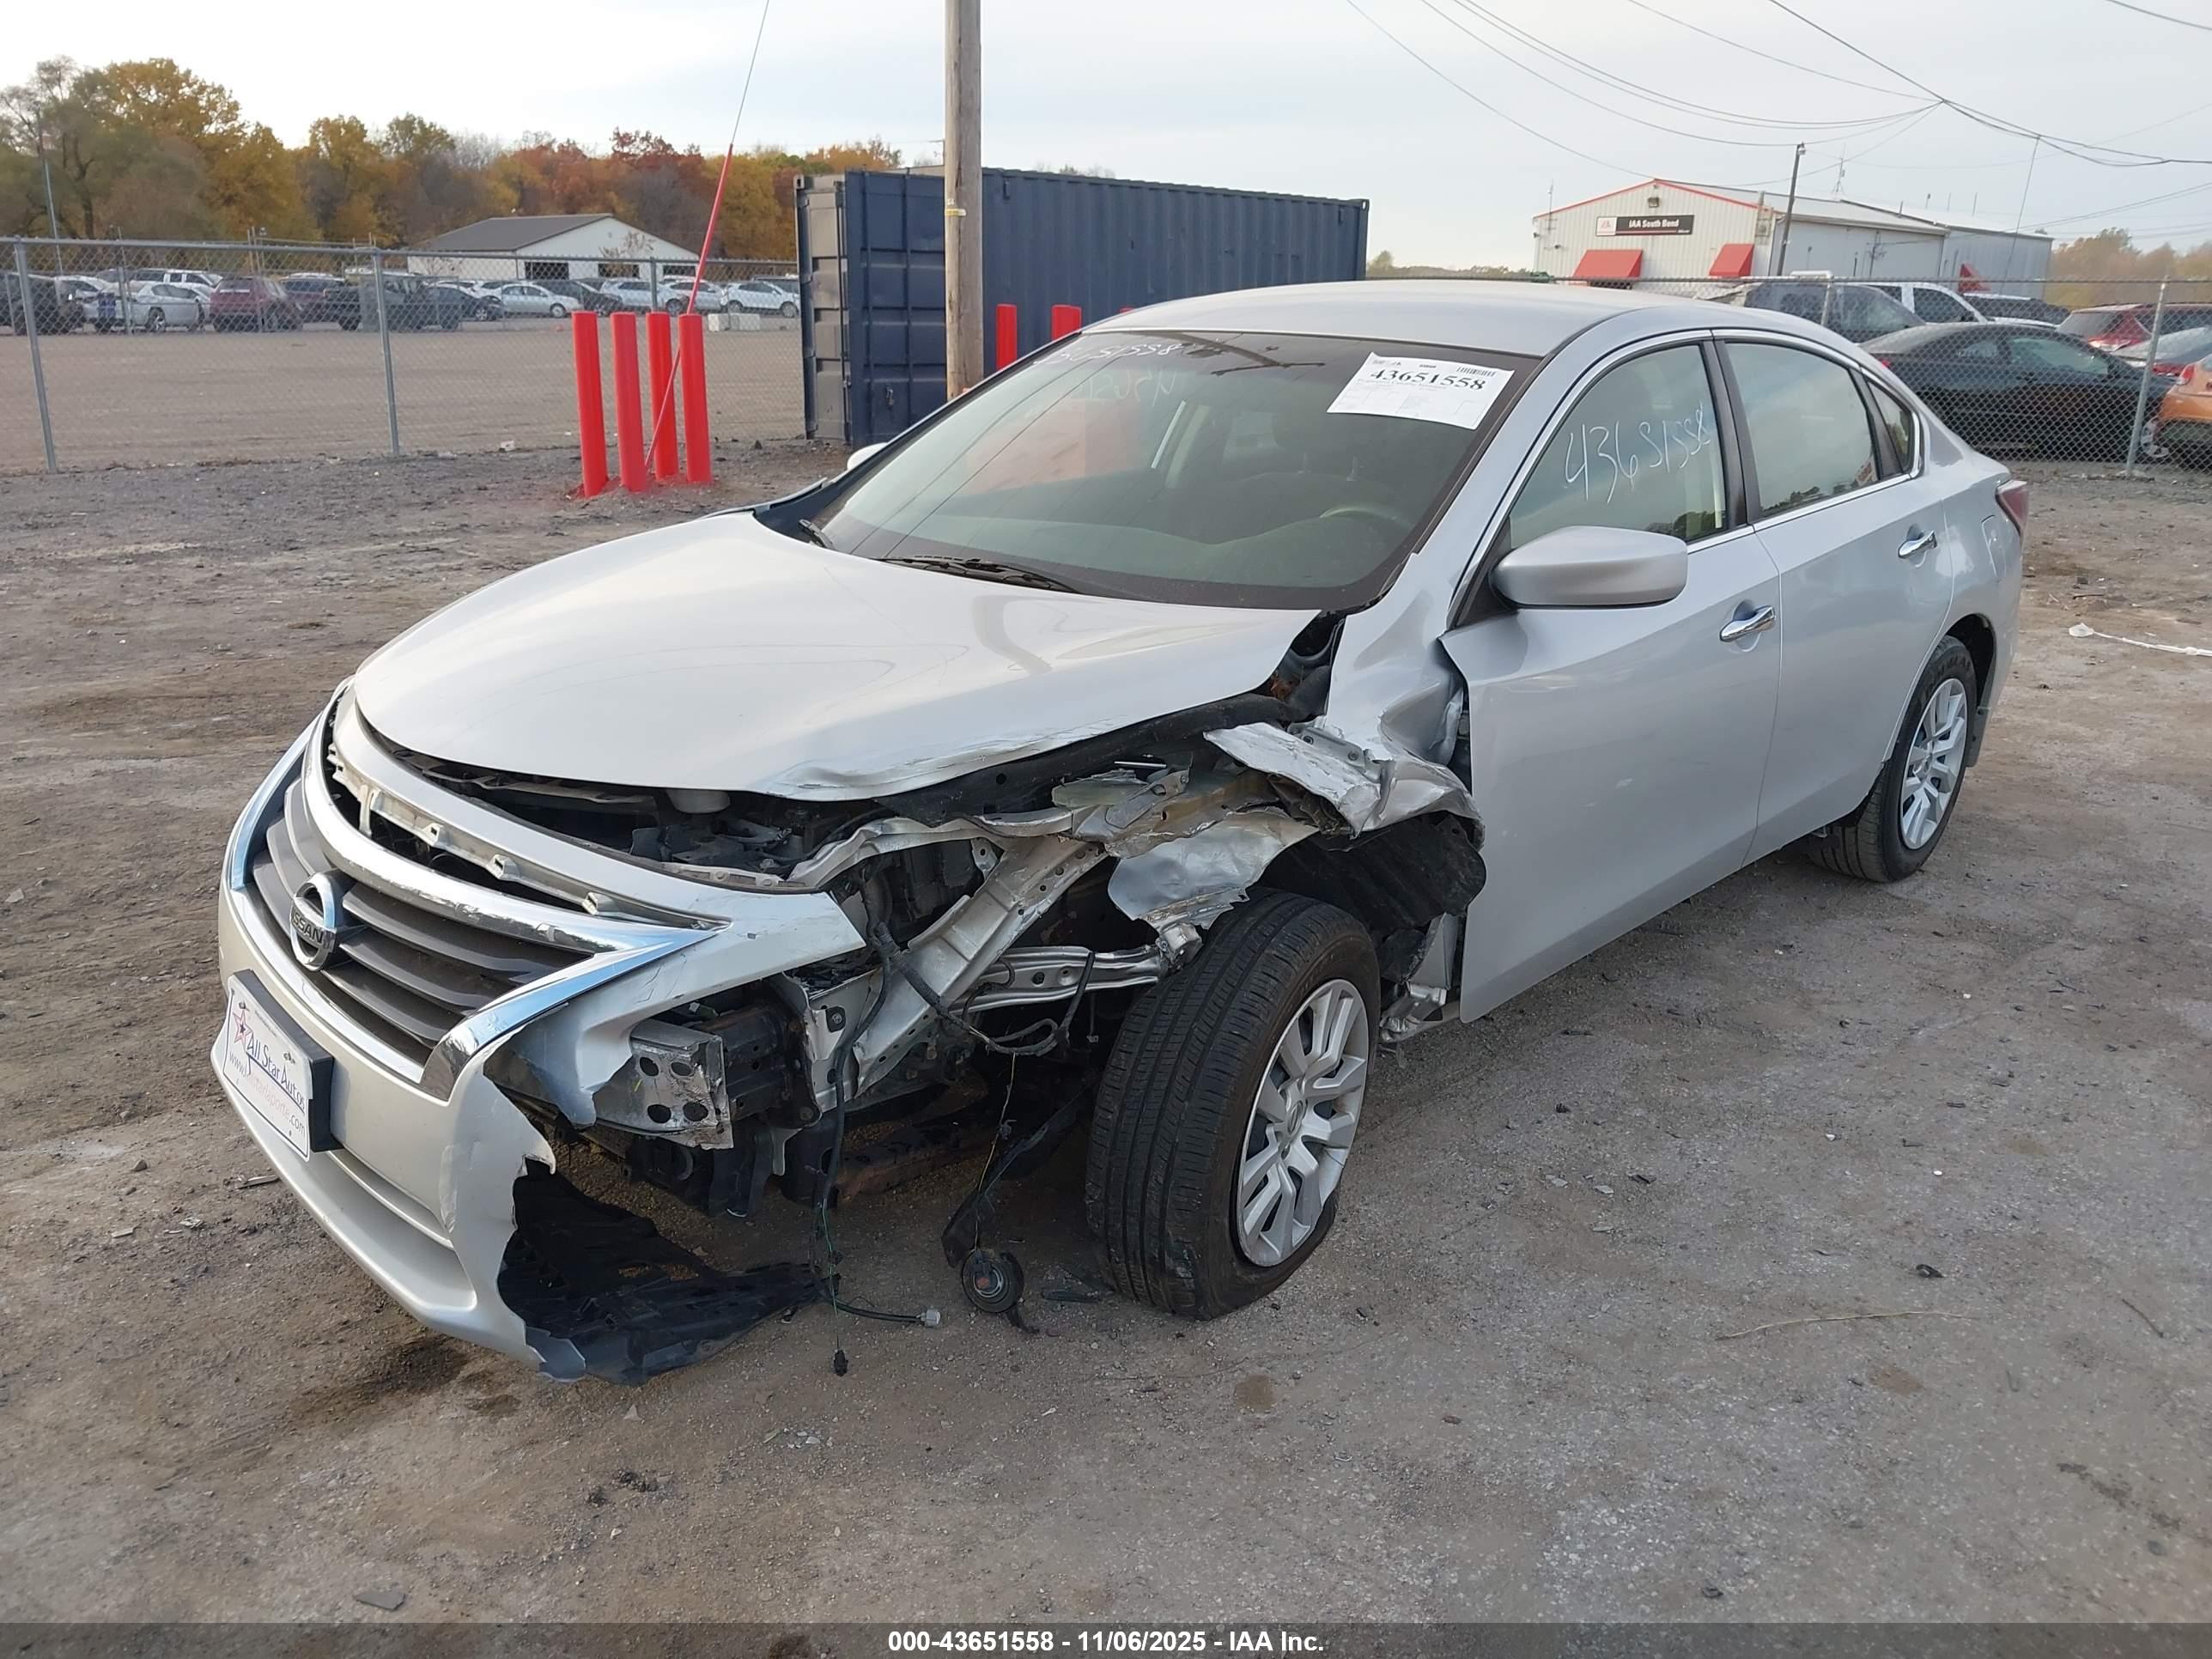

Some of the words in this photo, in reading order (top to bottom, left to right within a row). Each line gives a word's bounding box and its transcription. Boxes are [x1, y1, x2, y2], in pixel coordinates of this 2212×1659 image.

[1642, 219, 1661, 228] South
[1370, 368, 1486, 390] 43651558
[1565, 400, 1711, 503] 43651558
[292, 908, 324, 944] SSAN
[246, 1032, 261, 1060] All
[261, 1044, 281, 1079] Star
[281, 1064, 307, 1111] Autos
